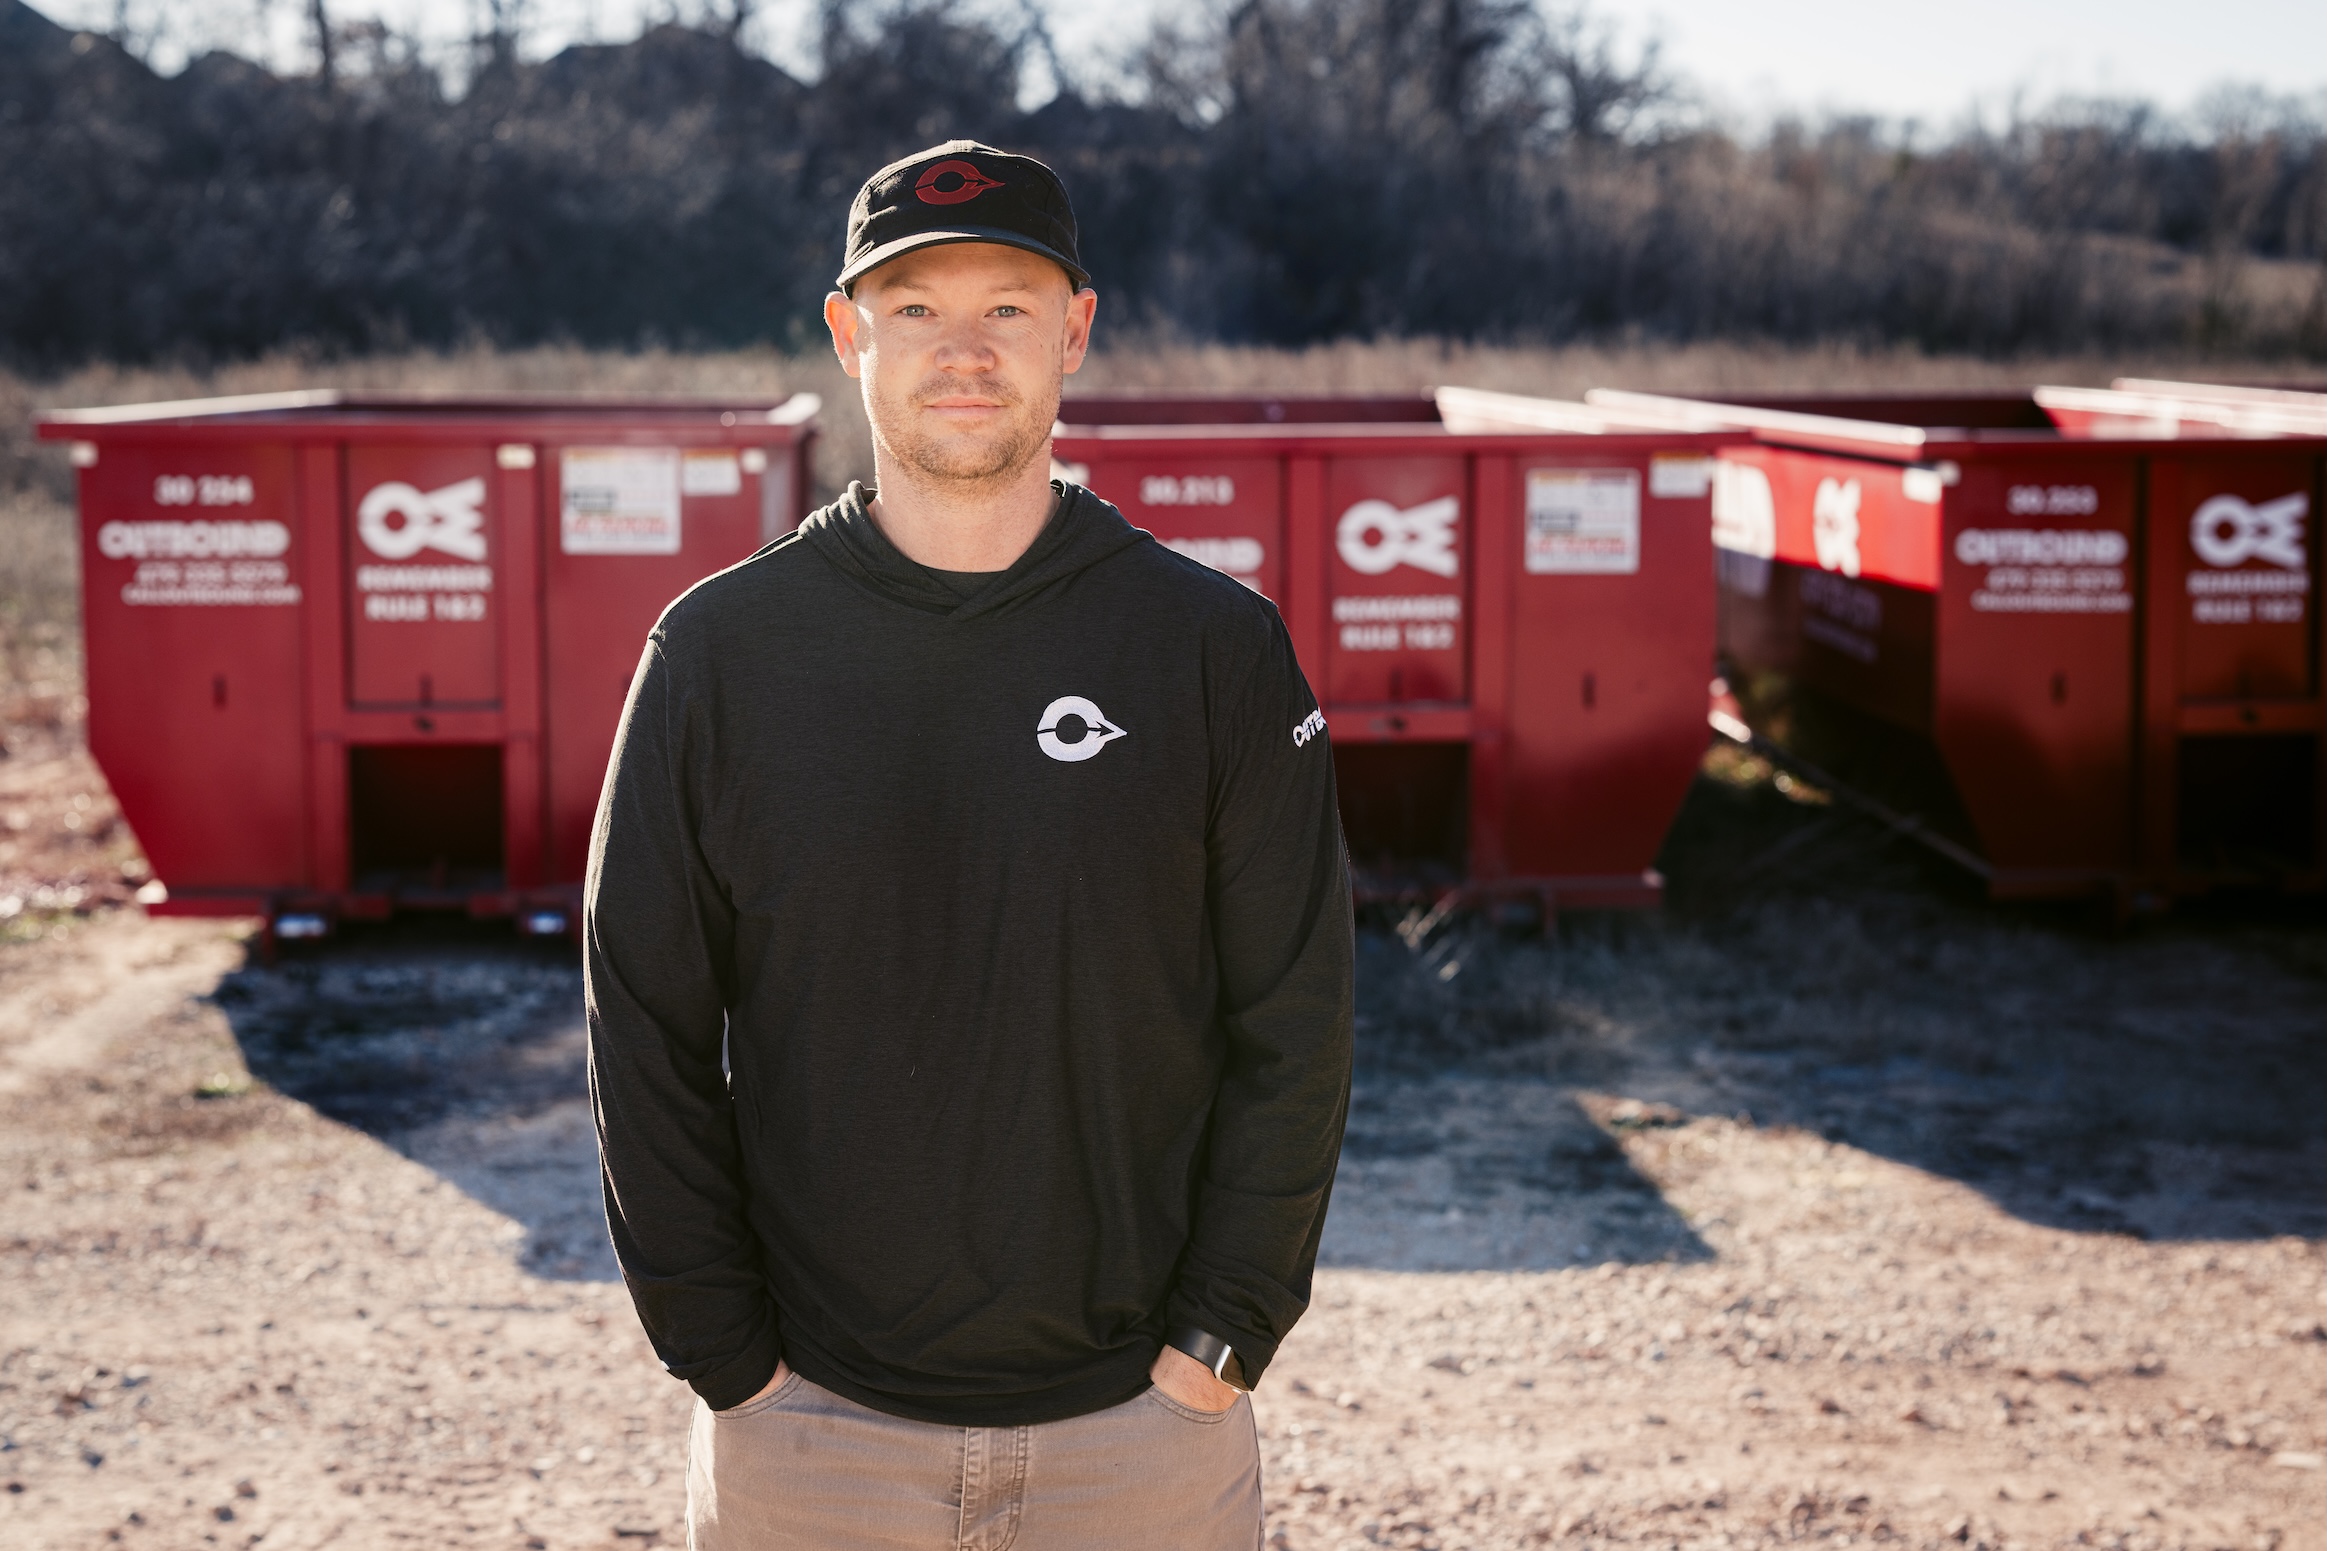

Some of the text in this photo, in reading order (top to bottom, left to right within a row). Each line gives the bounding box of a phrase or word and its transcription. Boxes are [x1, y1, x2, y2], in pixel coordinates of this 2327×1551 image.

[155, 476, 252, 505] 30 254
[101, 522, 288, 557] OUTBOUND
[1957, 530, 2126, 563] OUTBOUND
[359, 566, 492, 591] REMEMBER
[2189, 572, 2307, 594] REMEMBER
[367, 596, 427, 620] RULE
[1335, 598, 1460, 620] REMEMBER
[2196, 599, 2251, 621] RULE
[1343, 627, 1399, 648] RULE
